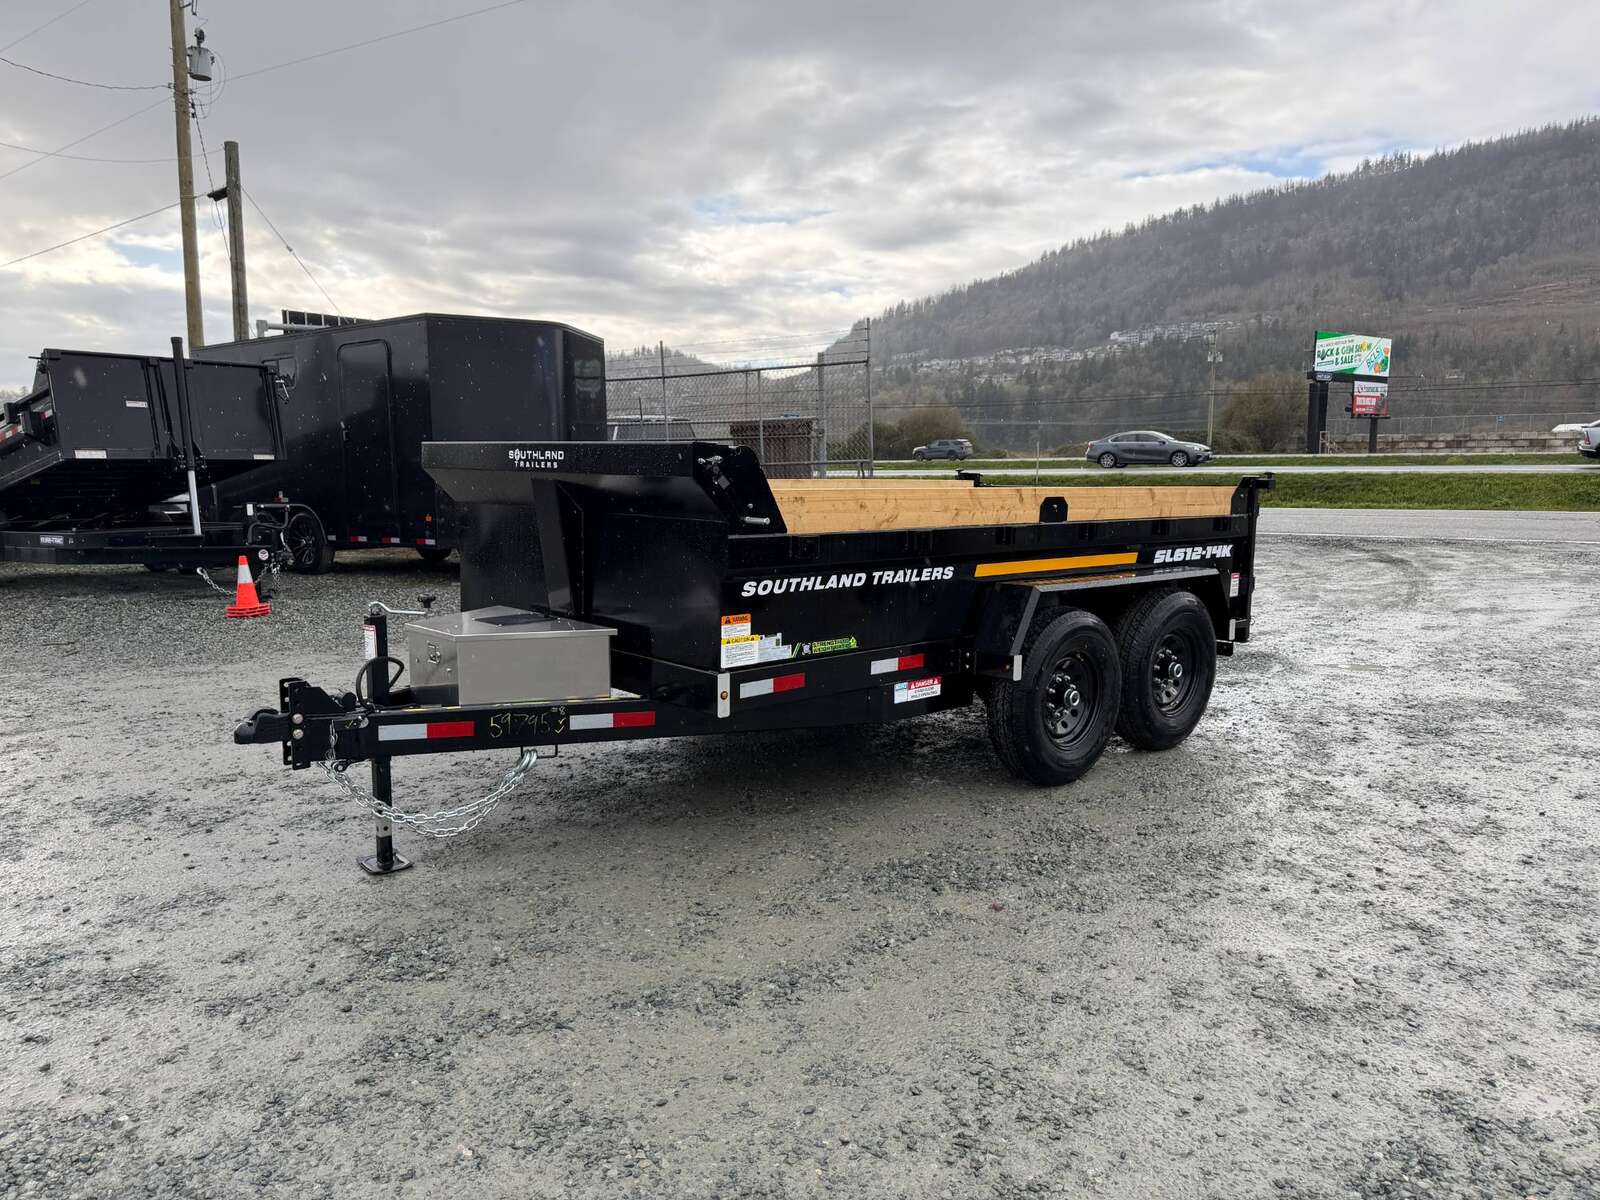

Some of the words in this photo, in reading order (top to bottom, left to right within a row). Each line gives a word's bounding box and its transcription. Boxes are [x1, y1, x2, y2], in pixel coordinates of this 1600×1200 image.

[1340, 355, 1354, 365] SALE
[508, 448, 565, 461] SOUTHLAND
[514, 461, 558, 469] TRAILERS
[1153, 544, 1233, 563] SL612-14K
[741, 572, 867, 598] SOUTHLAND
[872, 565, 955, 586] TRAILERS
[915, 679, 934, 688] DANGER
[490, 712, 551, 739] 59795
